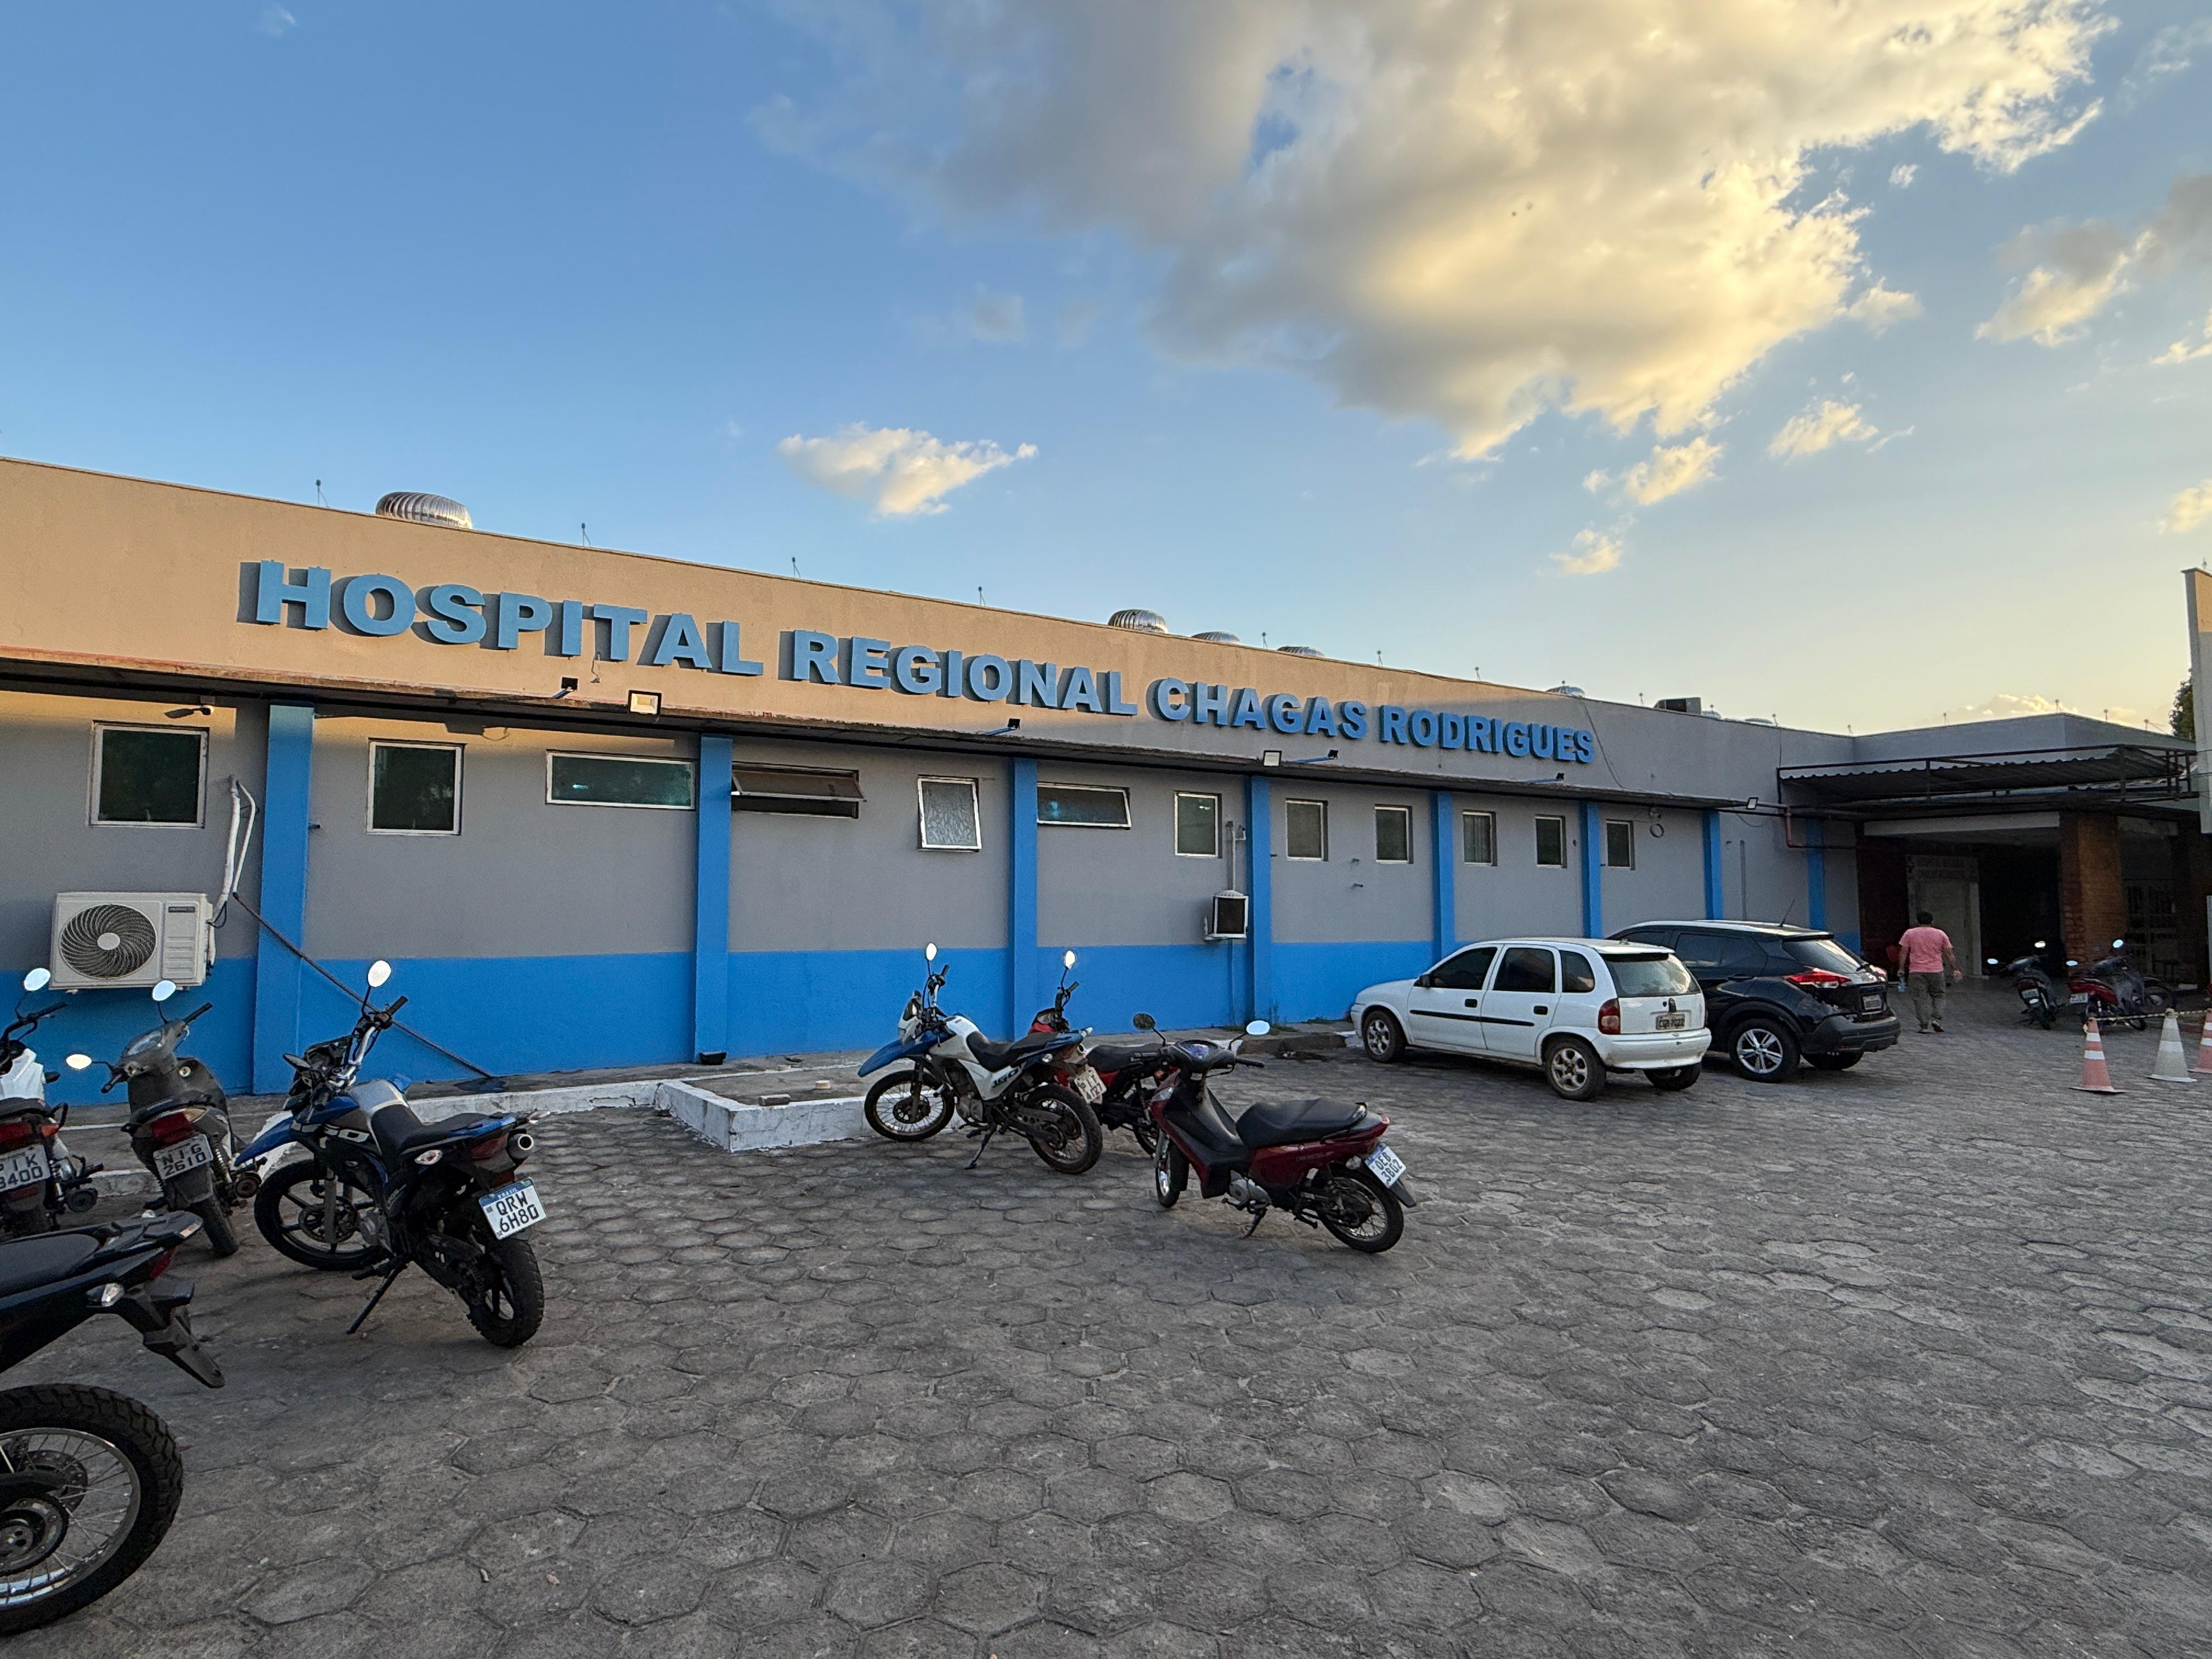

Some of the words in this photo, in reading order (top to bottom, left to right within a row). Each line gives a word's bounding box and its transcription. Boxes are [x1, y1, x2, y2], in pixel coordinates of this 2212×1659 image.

[255, 558, 764, 677] HOSPITAL
[792, 629, 1138, 716] REGIONAL
[1155, 676, 1368, 740] CHAGAS
[1379, 704, 1595, 764] RODRIGUES
[161, 1143, 202, 1166] NIG
[163, 1152, 206, 1176] 2610
[1375, 1152, 1391, 1170] OEB
[496, 1190, 528, 1216] QRW
[500, 1204, 539, 1232] 6H80
